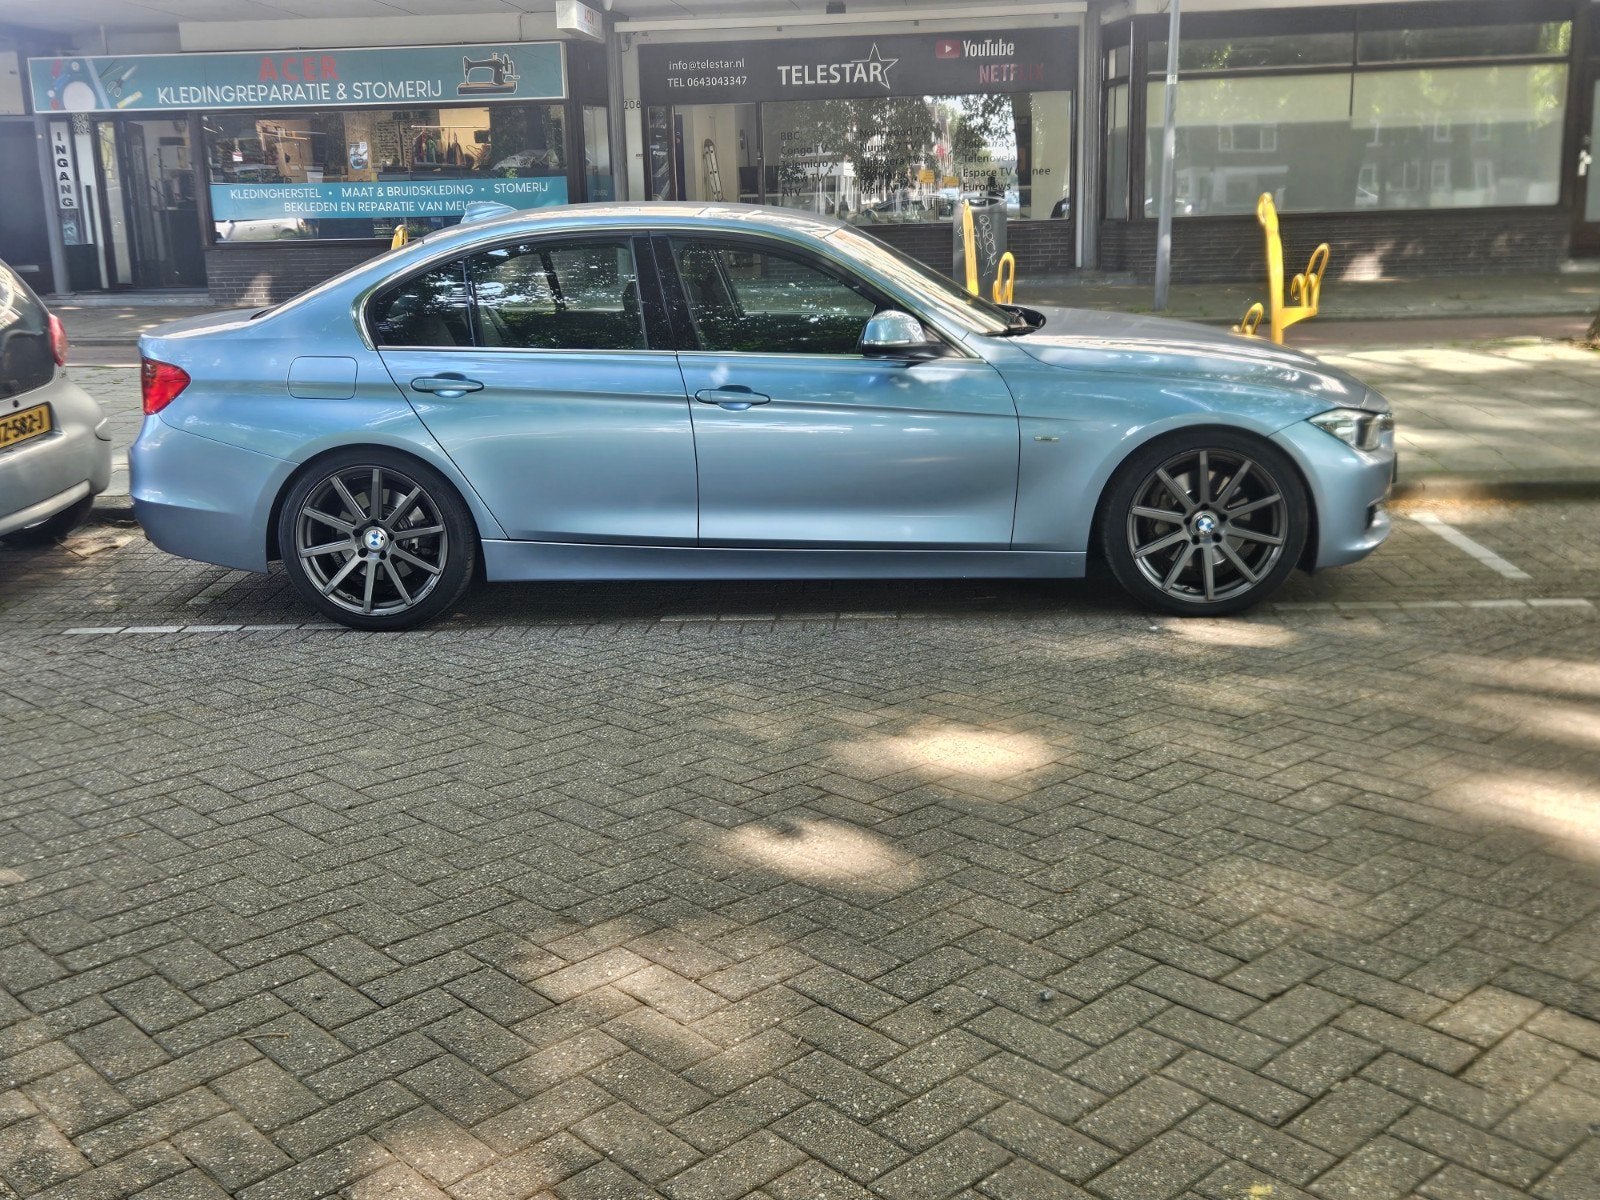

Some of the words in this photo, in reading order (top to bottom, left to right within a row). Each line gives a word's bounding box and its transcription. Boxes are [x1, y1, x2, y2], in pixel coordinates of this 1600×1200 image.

[963, 39, 1015, 57] YouTube
[259, 55, 338, 82] ACER
[668, 58, 745, 70] info@telestar.nl
[777, 62, 883, 86] TELESTAR
[977, 63, 1044, 84] NETFLIX
[667, 77, 685, 88] TEL
[687, 75, 747, 87] 0643043347
[157, 82, 331, 104] KLEDINGREPARATIE
[336, 82, 348, 100] &
[352, 79, 442, 99] STOMERIJ
[623, 100, 641, 110] 208
[780, 131, 801, 141] BBC
[914, 126, 930, 136] TV
[55, 131, 75, 208] INGANG
[963, 167, 997, 179] Espace
[999, 166, 1013, 177] TV
[230, 187, 322, 200] KLEDINGHERSTEL
[341, 186, 375, 198] MAAT
[377, 186, 385, 197] &
[387, 184, 474, 197] BRUIDSKLEDING
[494, 182, 548, 194] STOMERIJ
[963, 183, 1011, 193] Euronews
[284, 202, 338, 213] BEKLEDEN
[341, 202, 355, 212] EN
[358, 201, 415, 212] REPARATIE
[417, 201, 443, 211] VAN
